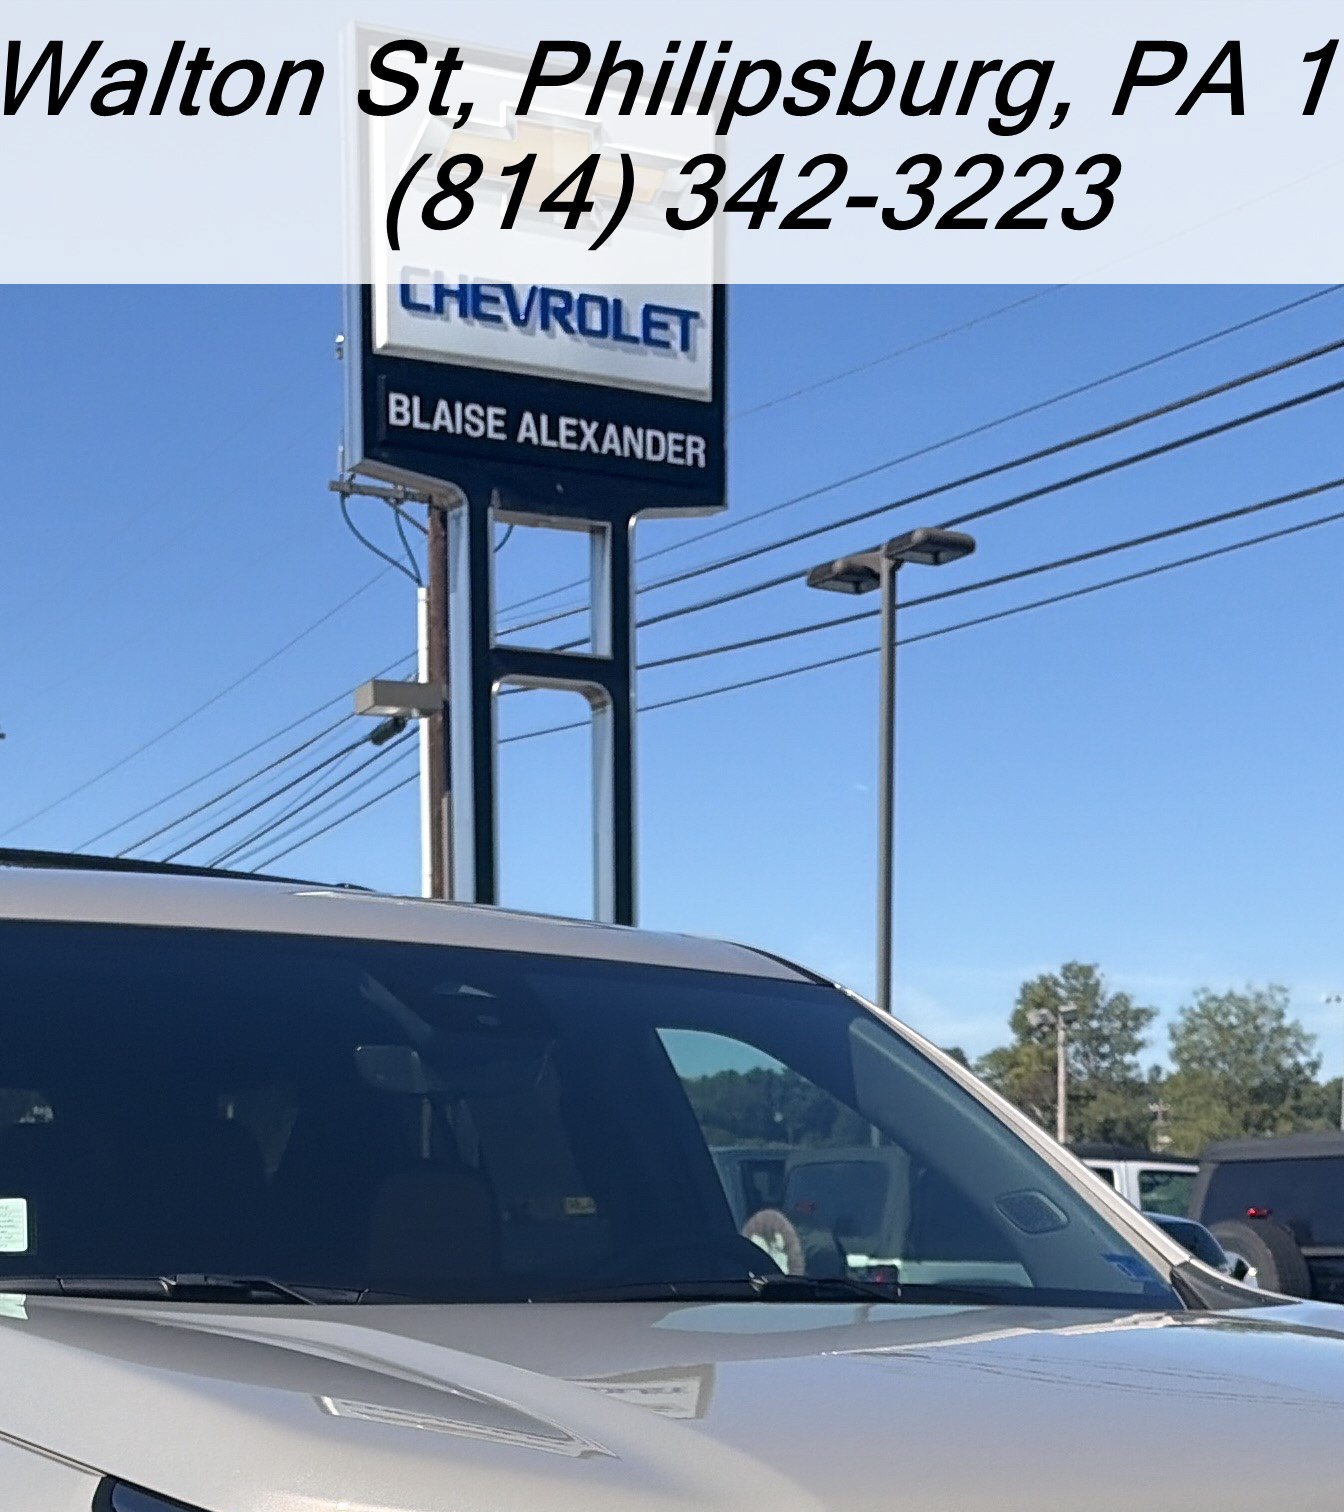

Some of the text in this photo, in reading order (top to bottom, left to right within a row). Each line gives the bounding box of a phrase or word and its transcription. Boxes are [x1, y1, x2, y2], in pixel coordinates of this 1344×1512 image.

[399, 265, 702, 353] CHEVROLET
[388, 391, 707, 469] BLAISE ALEXANDER
